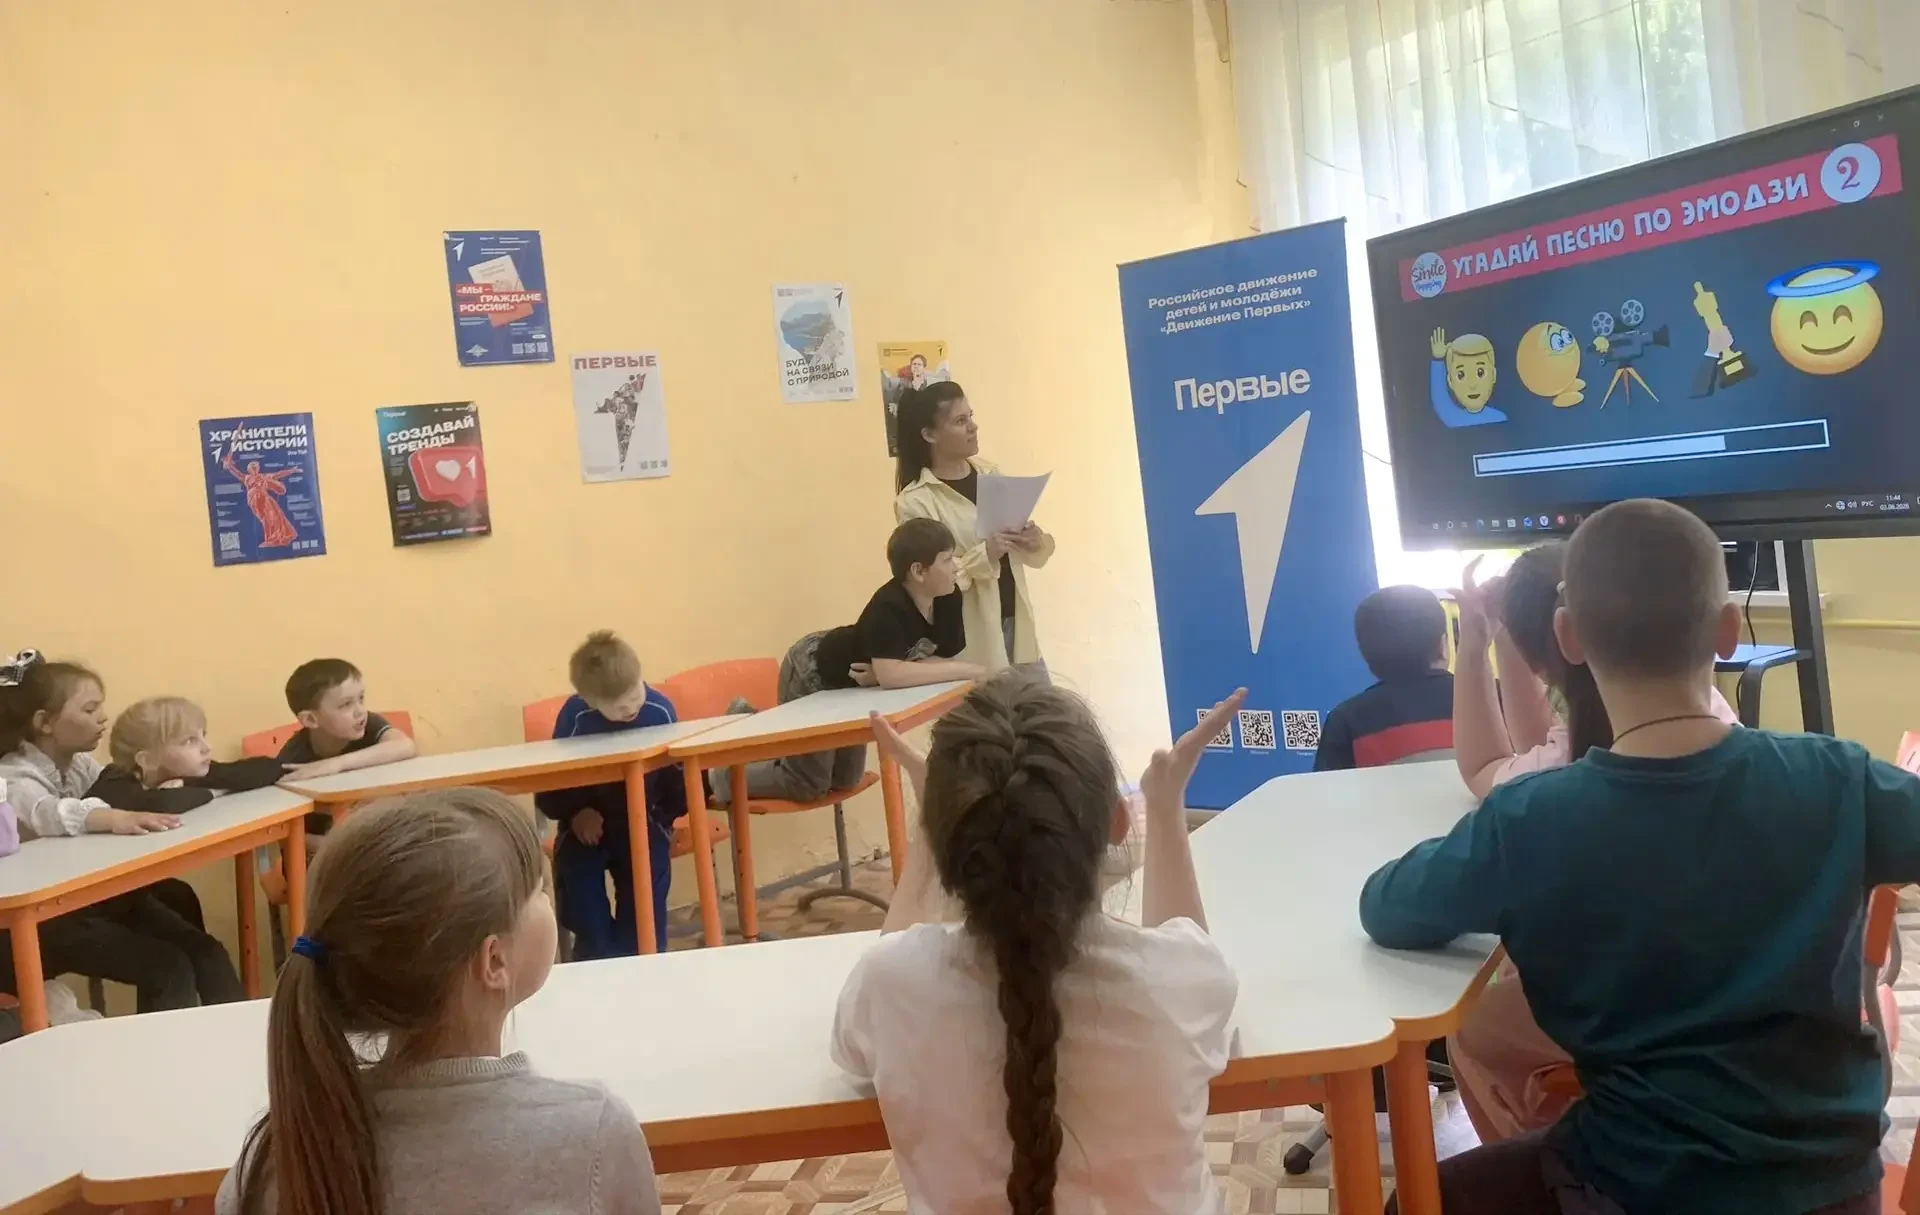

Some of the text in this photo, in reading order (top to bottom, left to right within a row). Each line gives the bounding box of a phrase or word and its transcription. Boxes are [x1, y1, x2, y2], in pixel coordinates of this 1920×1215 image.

[1452, 156, 1861, 279] УГАДАЙ ПЕСНЮ ПО ЭМОДЗИ 2
[480, 293, 541, 303] ГРАЖДАНЕ
[1148, 268, 1318, 309] Российское движение
[1165, 286, 1303, 321] детей и молодёжи
[1160, 300, 1311, 335] «Движение Первых»
[574, 355, 657, 370] ПЕРВЫЕ
[802, 363, 834, 374] СВЯЗИ
[788, 368, 849, 386] С ПРИРОДОЙ
[1174, 368, 1311, 414] Первые
[209, 425, 307, 442] ХРАНИТЕЛИ
[386, 415, 475, 443] СОЗДАВАЙ
[231, 437, 308, 452] ИСТОРИИ
[387, 433, 456, 456] ТРЕНДЫ
